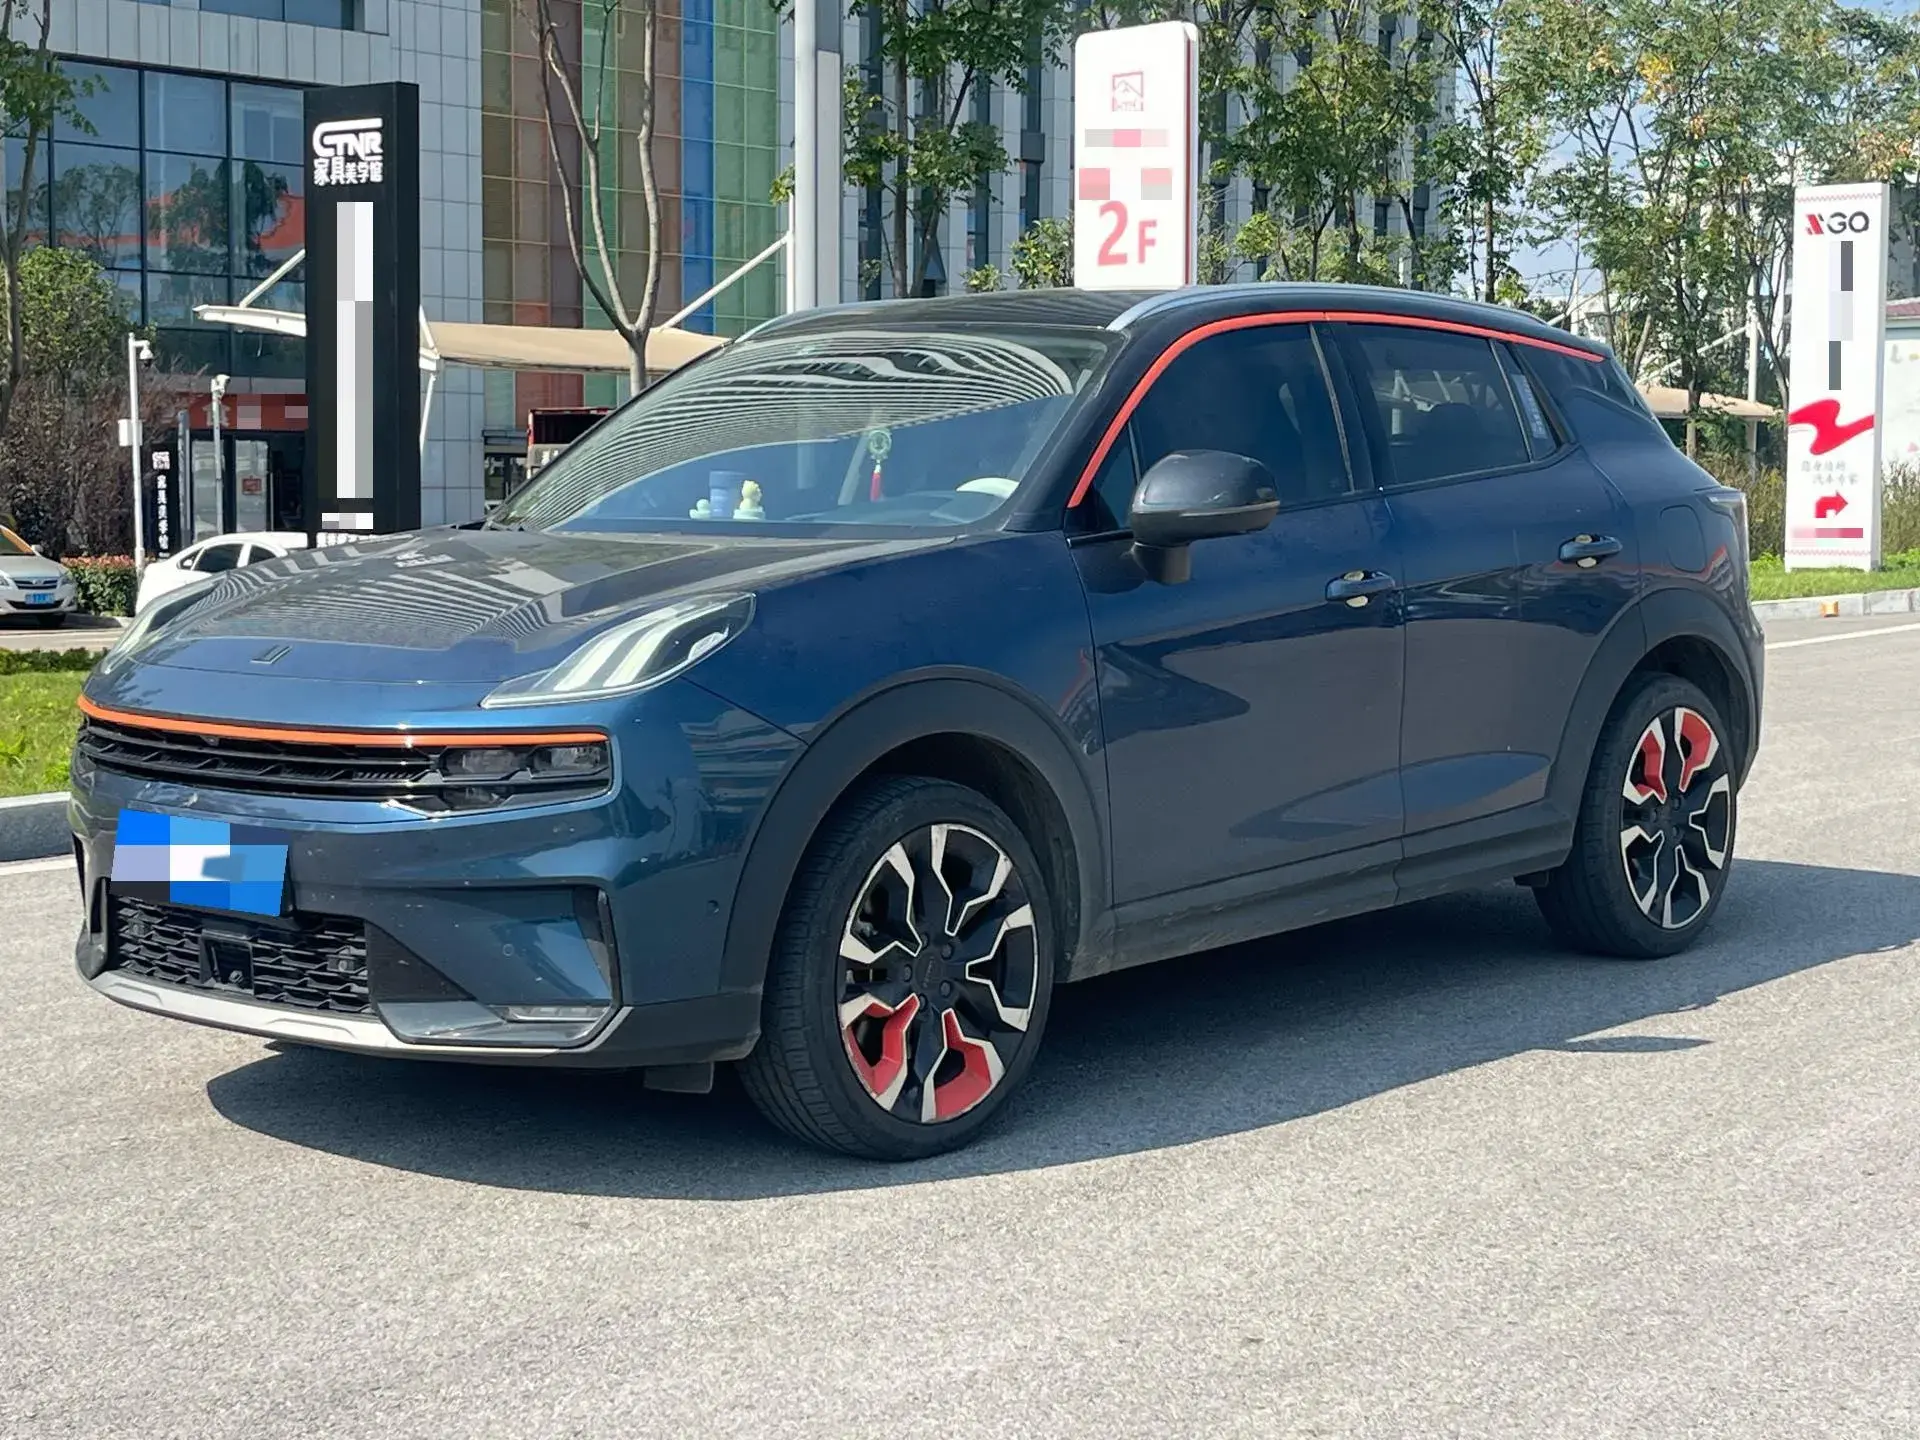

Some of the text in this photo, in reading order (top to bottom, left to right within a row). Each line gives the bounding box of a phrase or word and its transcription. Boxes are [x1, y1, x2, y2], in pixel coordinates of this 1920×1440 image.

[313, 156, 384, 186] 家具美学馆
[1097, 200, 1157, 267] 2F
